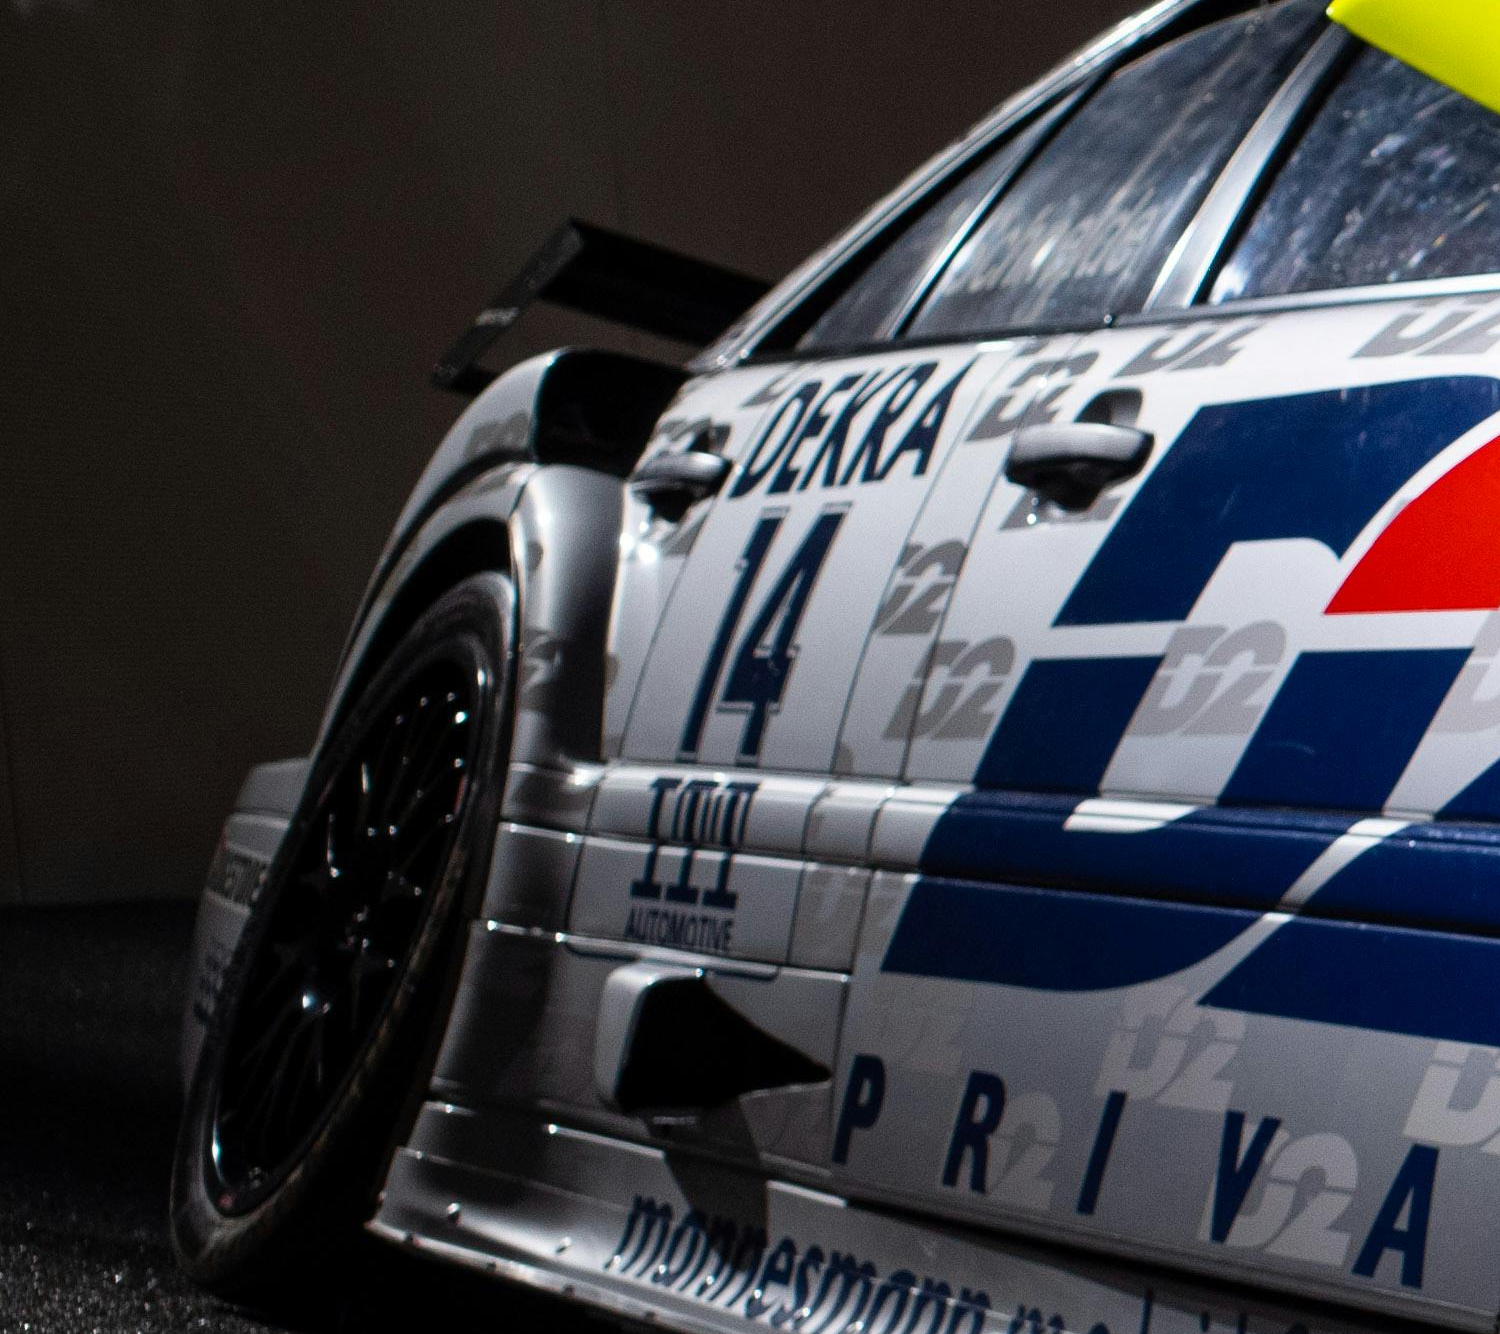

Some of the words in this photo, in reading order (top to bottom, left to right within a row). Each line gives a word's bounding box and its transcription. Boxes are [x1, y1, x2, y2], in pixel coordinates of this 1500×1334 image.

[728, 357, 978, 501] DEKRA
[677, 501, 854, 766] 14
[622, 908, 735, 955] AUTOMOTIVE
